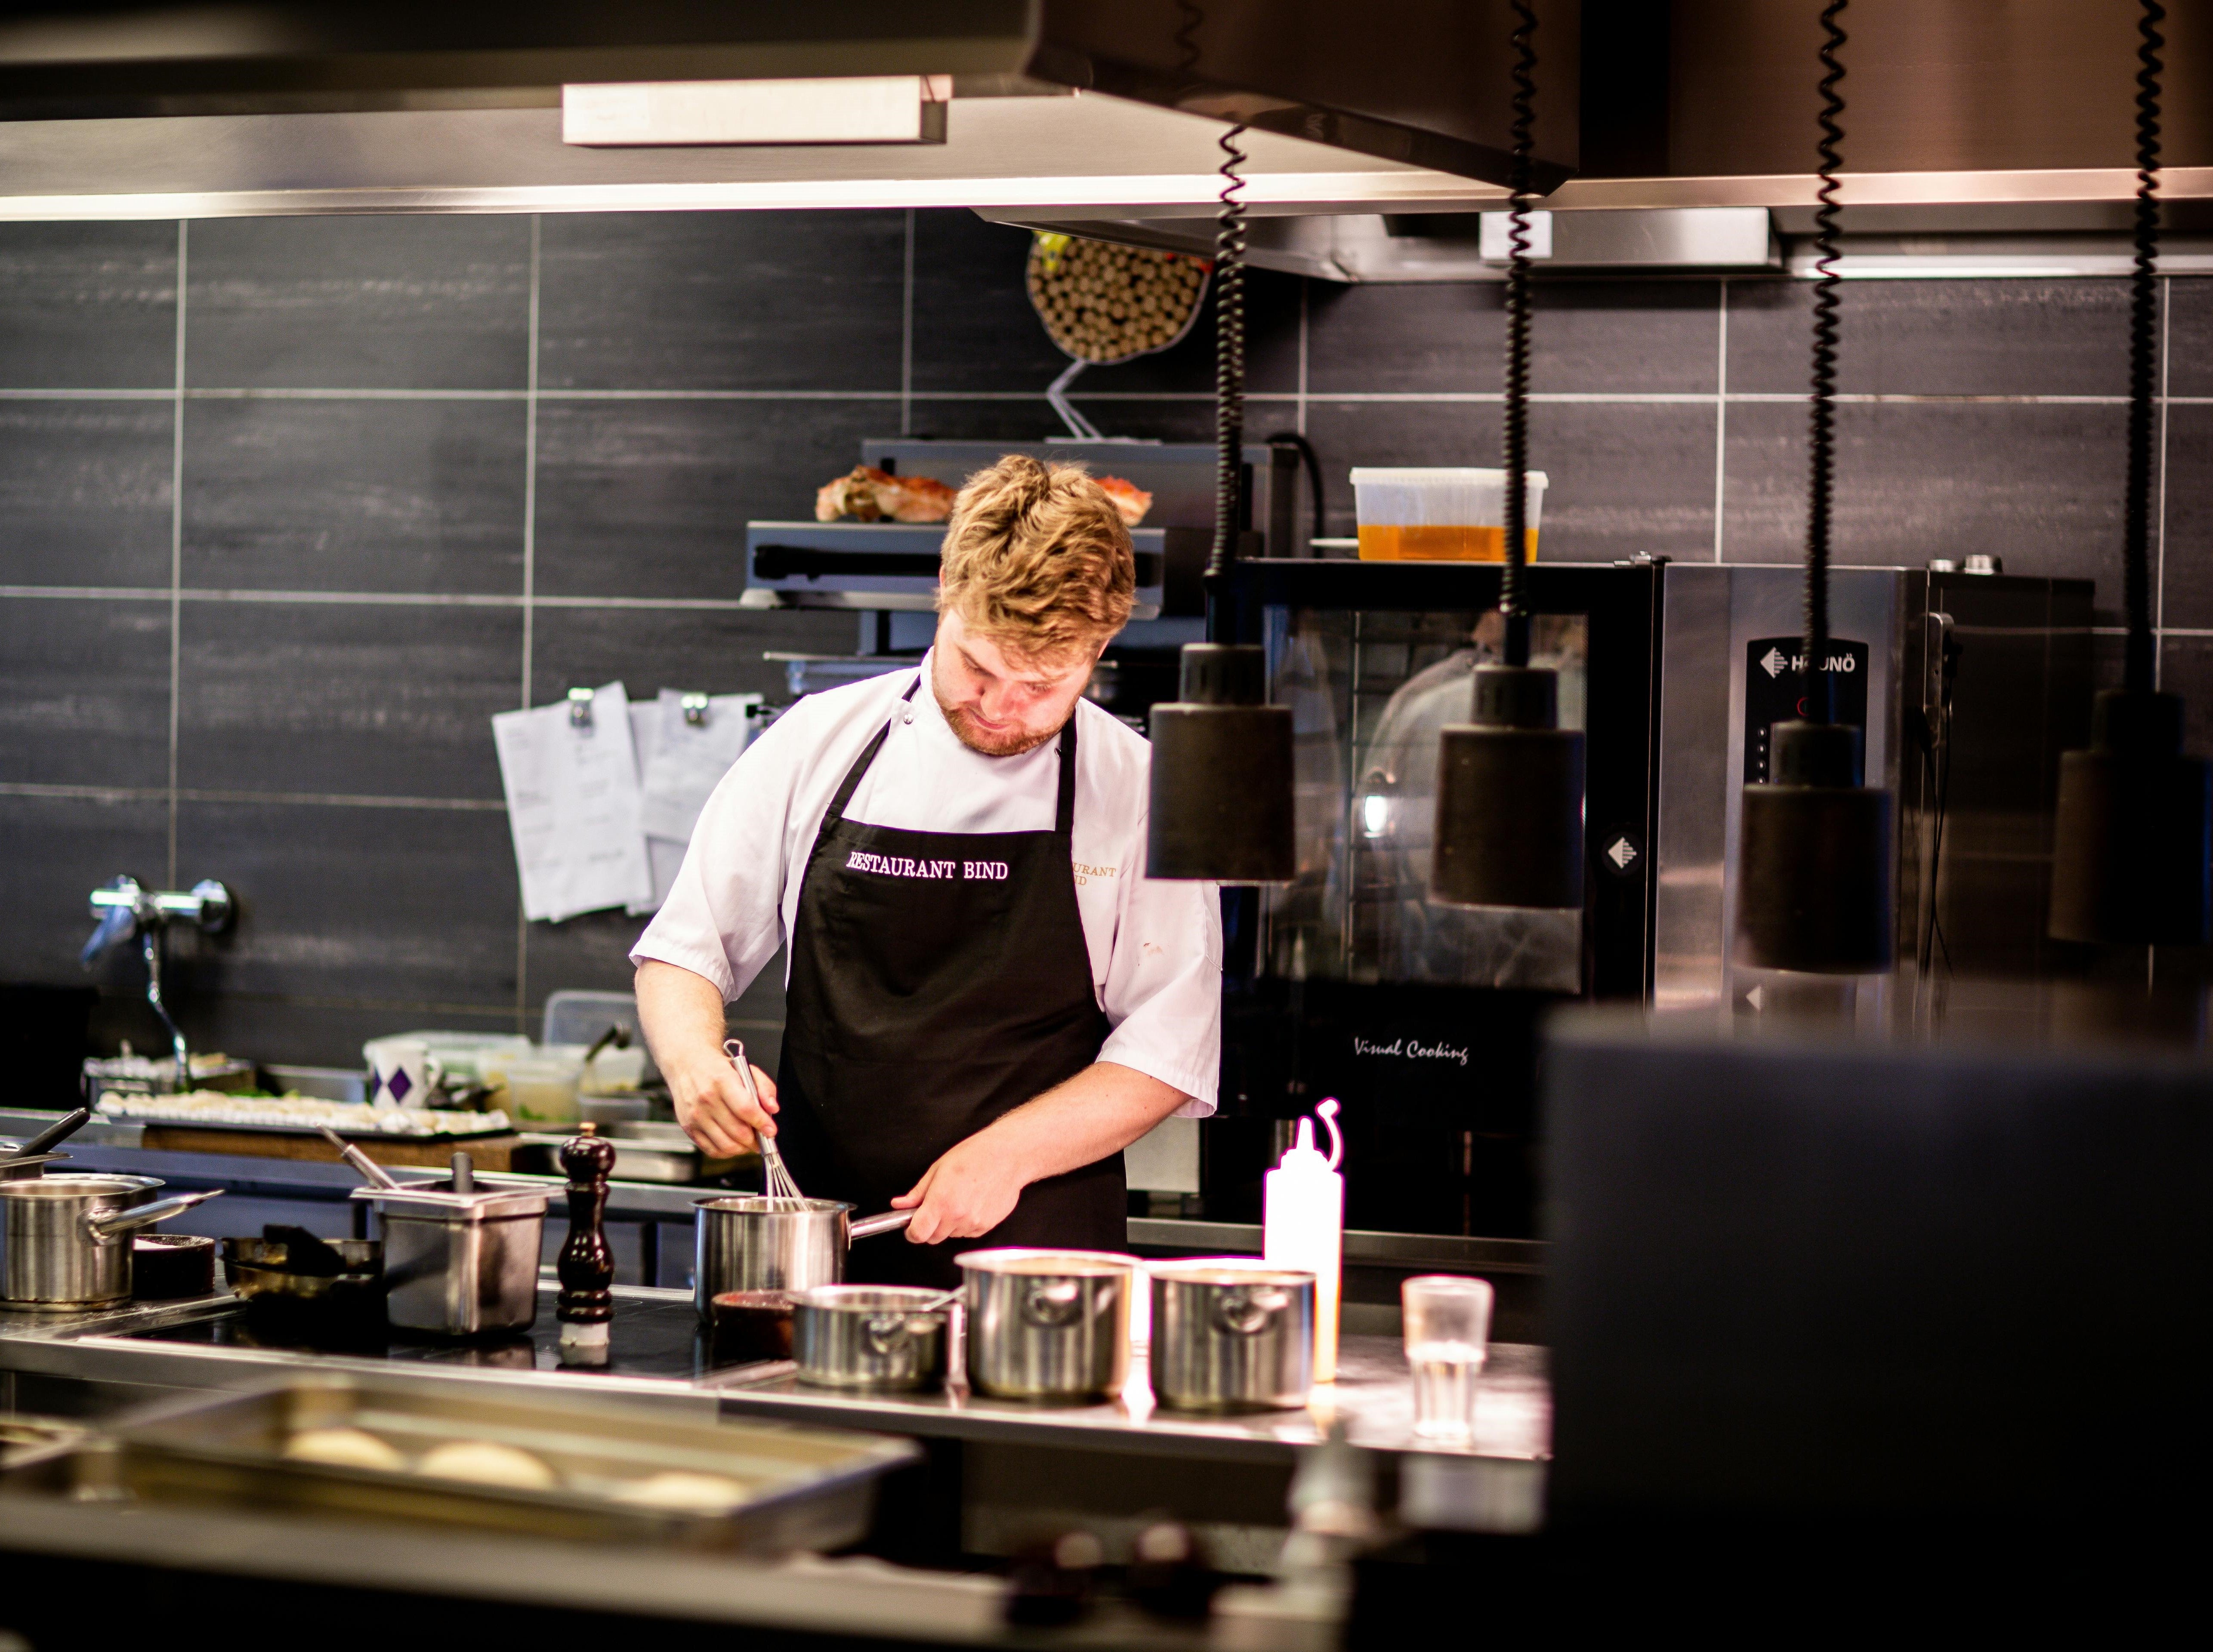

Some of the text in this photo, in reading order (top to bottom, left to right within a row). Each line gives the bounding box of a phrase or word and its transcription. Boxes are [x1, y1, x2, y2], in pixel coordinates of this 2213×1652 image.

[1792, 653, 1855, 672] HUNÖ
[846, 851, 1008, 879] RESTAURANT BIND
[1073, 862, 1116, 877] URANT
[1355, 1036, 1468, 1066] Visual Cooking
